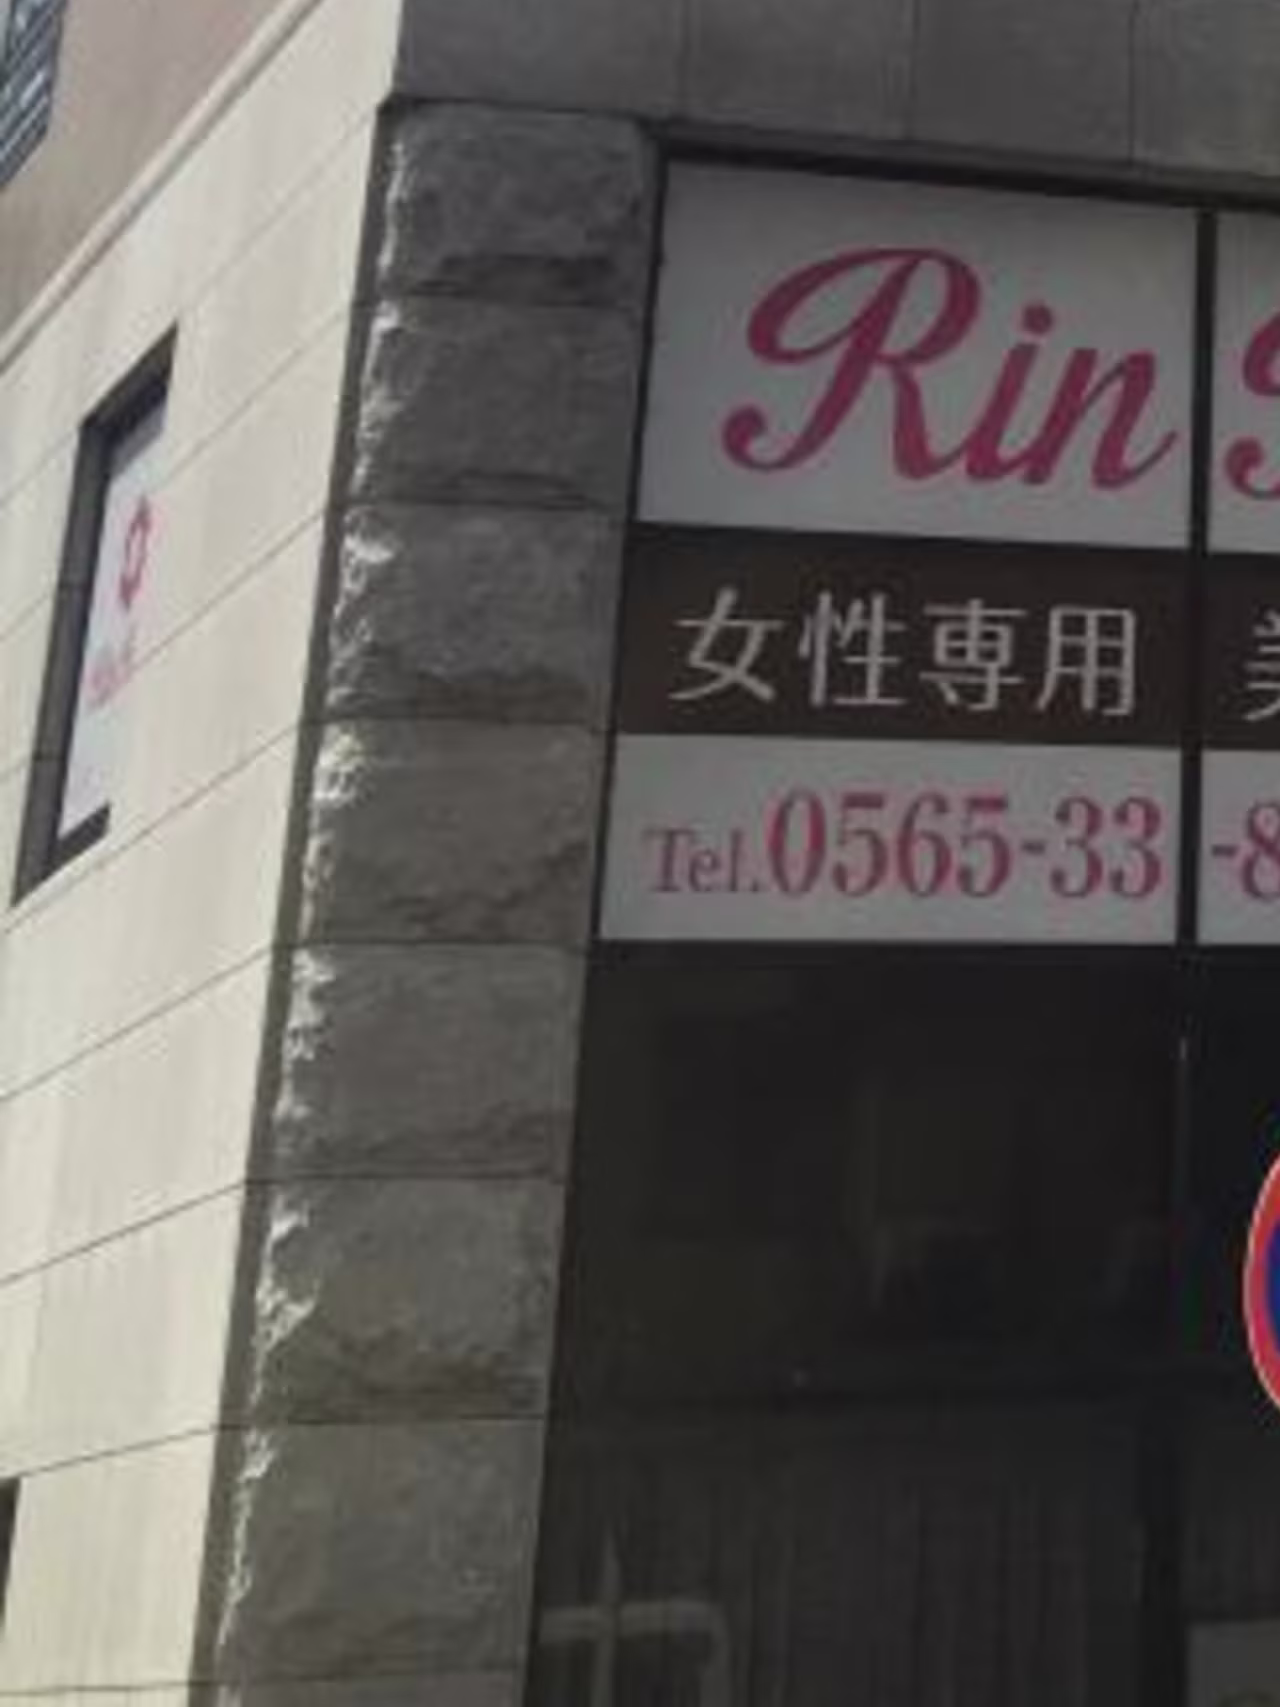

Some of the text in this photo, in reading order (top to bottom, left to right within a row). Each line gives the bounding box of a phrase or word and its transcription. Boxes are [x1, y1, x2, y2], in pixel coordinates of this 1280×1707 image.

[720, 246, 1179, 491] Rin
[667, 587, 1138, 718] 女性専用
